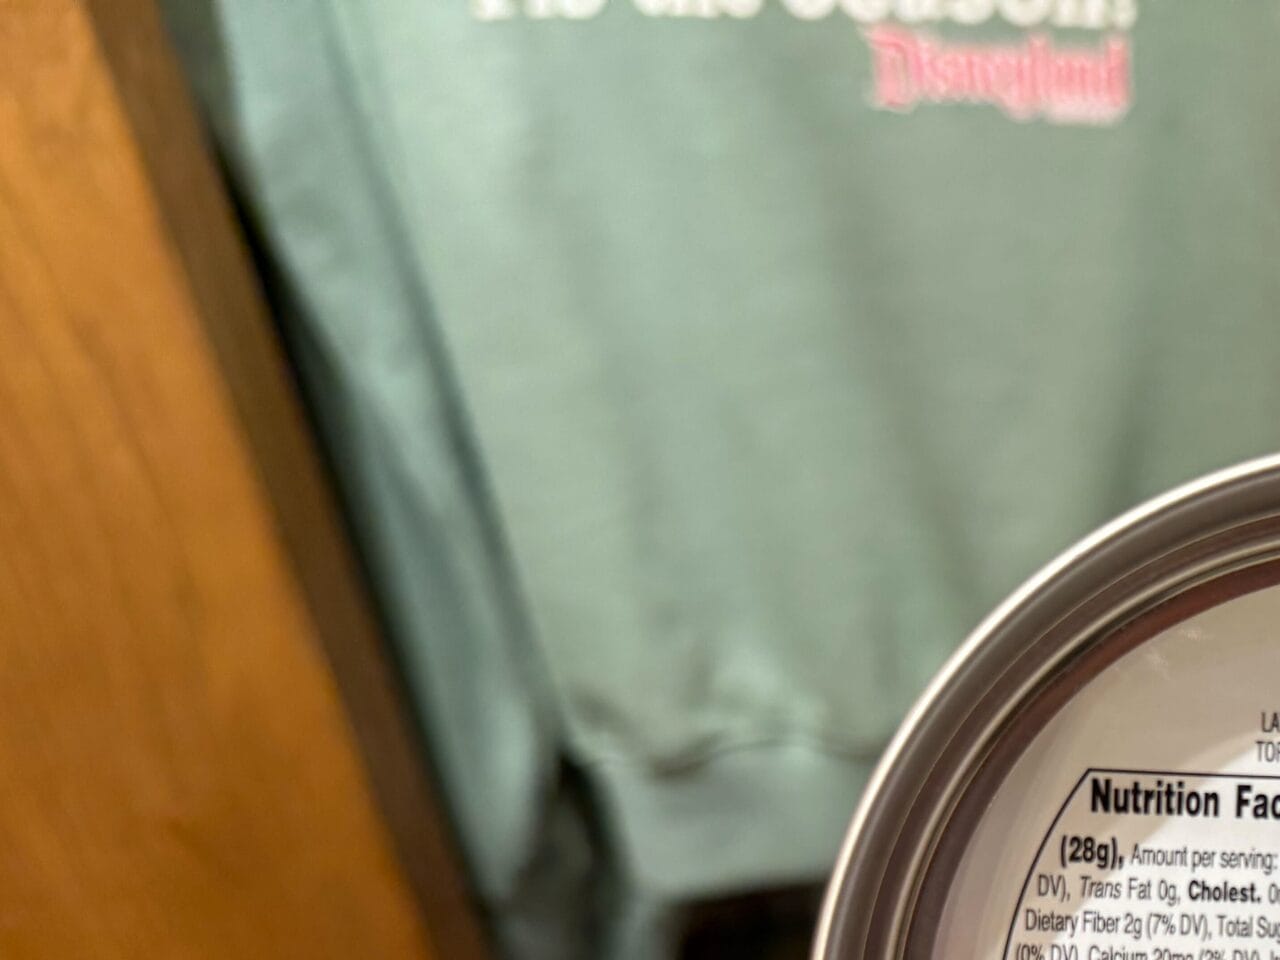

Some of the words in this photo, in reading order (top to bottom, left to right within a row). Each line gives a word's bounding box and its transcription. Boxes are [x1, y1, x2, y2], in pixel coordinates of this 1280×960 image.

[1091, 780, 1220, 820] Nutrition
[1060, 838, 1125, 874] (28g),
[1131, 844, 1188, 867] Amount
[1191, 850, 1216, 873] per
[1219, 847, 1278, 876] serving:
[1037, 873, 1074, 904] DV),
[1079, 876, 1122, 904] Trans
[1127, 877, 1152, 900] Fat
[1188, 879, 1261, 904] Cholest.
[1025, 909, 1078, 938] Dietary
[1082, 911, 1121, 934] Fiber
[1217, 916, 1253, 938] Total
